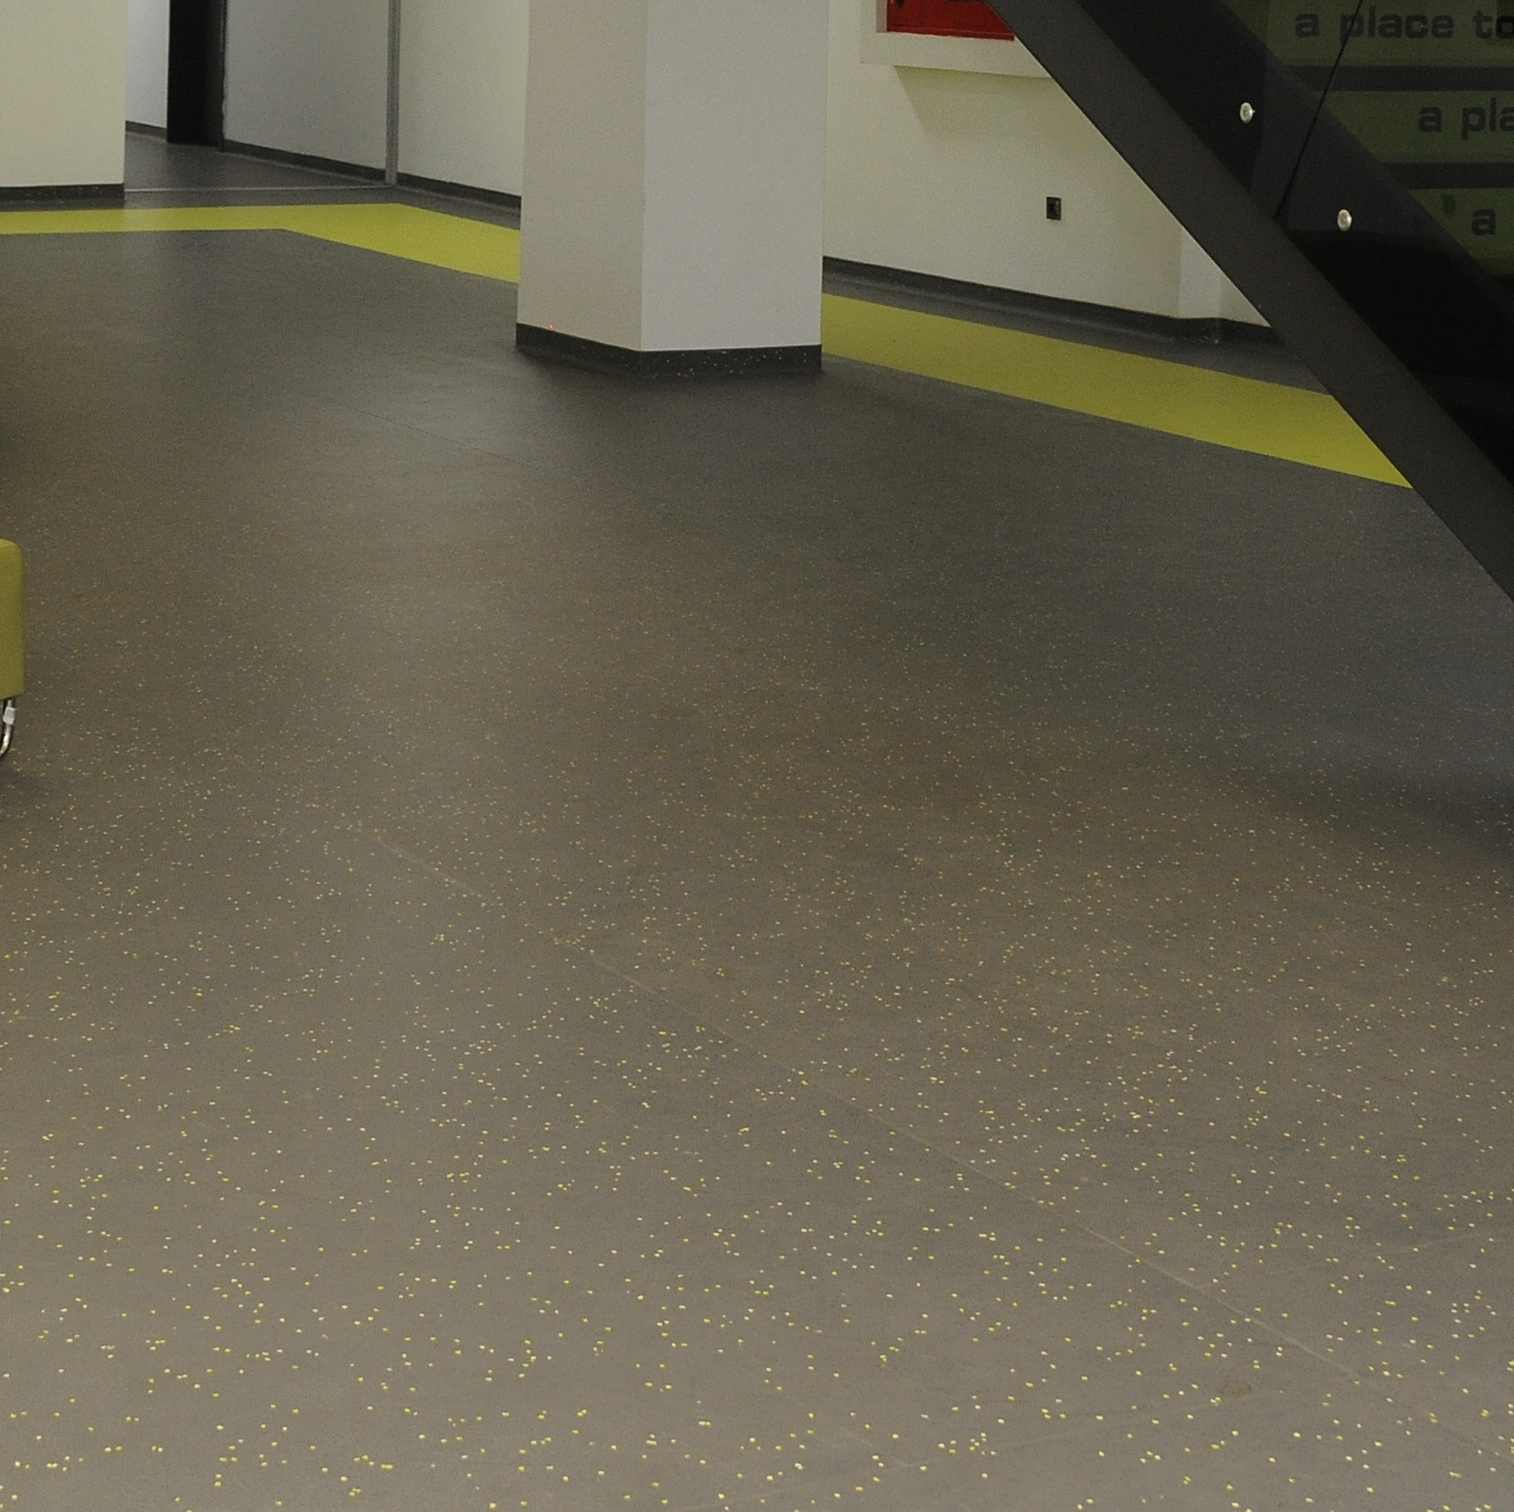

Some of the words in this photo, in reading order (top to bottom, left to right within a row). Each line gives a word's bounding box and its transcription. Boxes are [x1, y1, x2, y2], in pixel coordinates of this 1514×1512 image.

[1295, 12, 1320, 40] a
[1340, 7, 1456, 47] place
[1418, 106, 1443, 133] a
[1471, 207, 1497, 236] a
